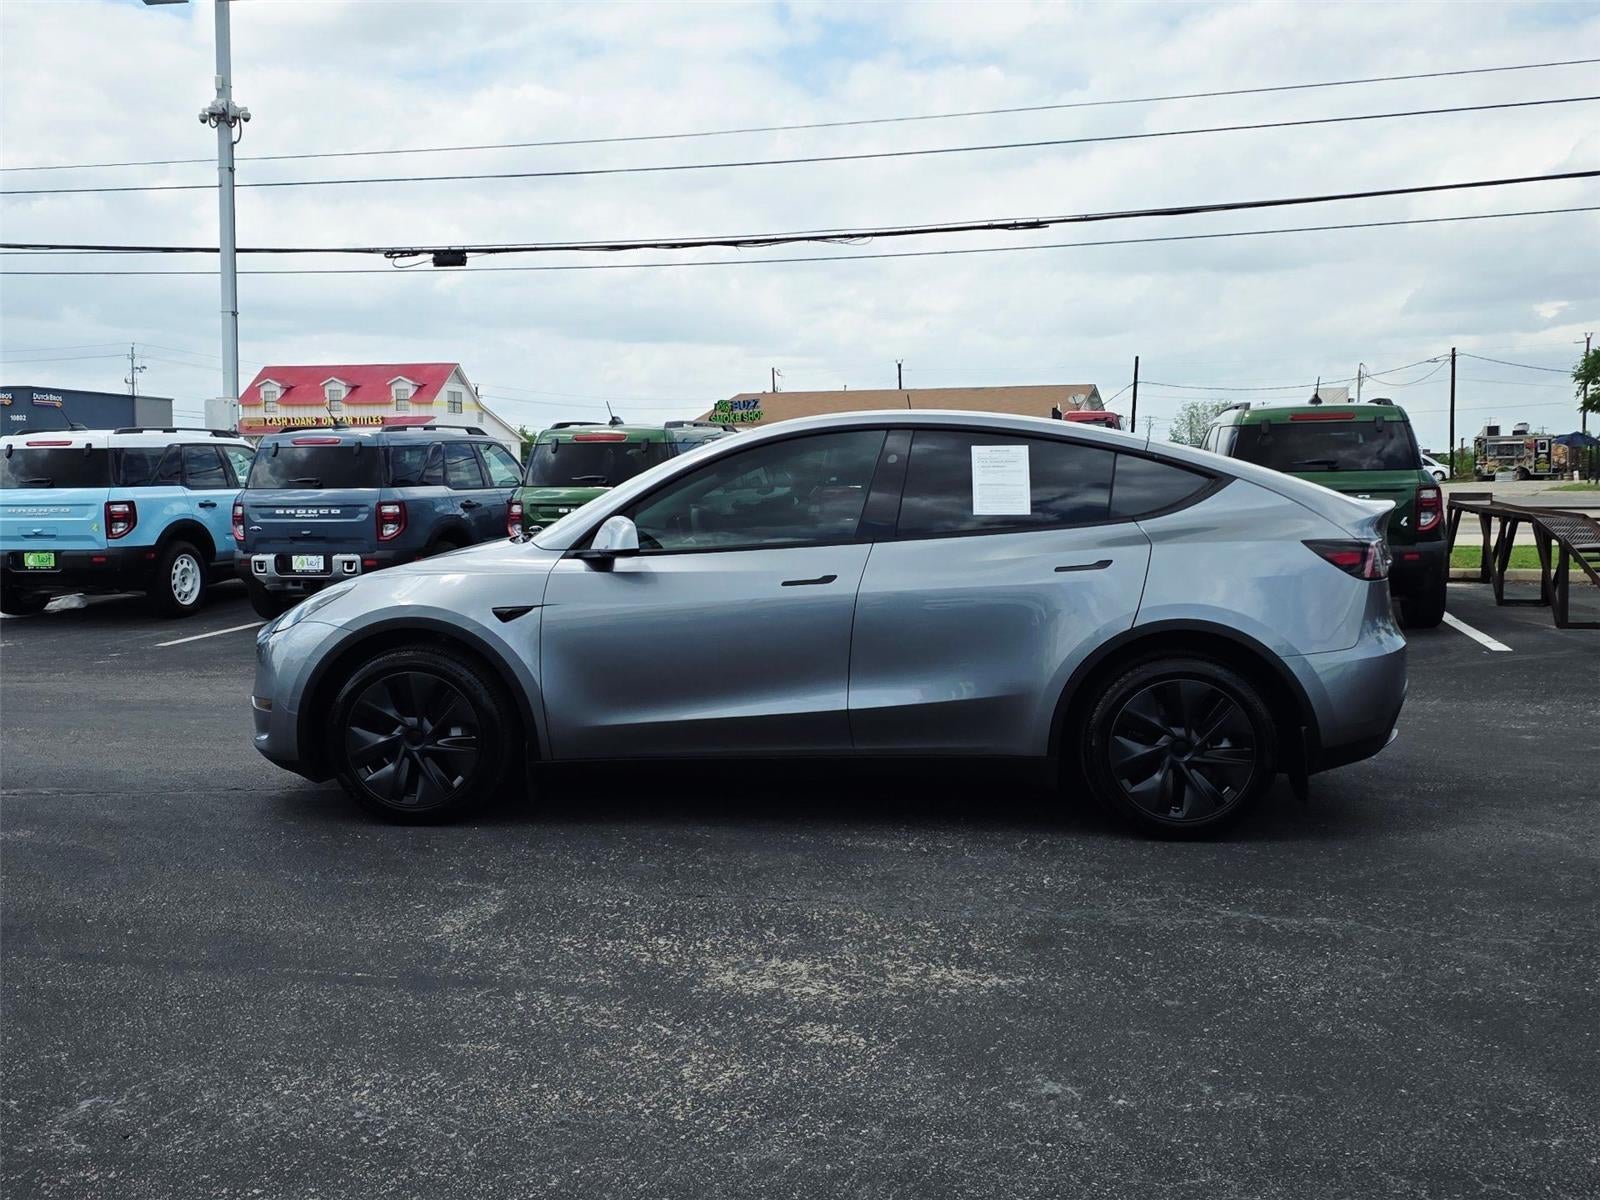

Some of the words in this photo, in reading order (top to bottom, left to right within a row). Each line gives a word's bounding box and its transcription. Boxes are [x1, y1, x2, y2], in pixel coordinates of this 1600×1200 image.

[732, 399, 760, 410] BUZZ
[266, 416, 288, 426] CASH
[290, 416, 317, 426] LOANS
[321, 416, 335, 426] ON
[356, 415, 383, 425] TITLES
[710, 411, 741, 423] SMOKE
[742, 409, 766, 422] SHOP
